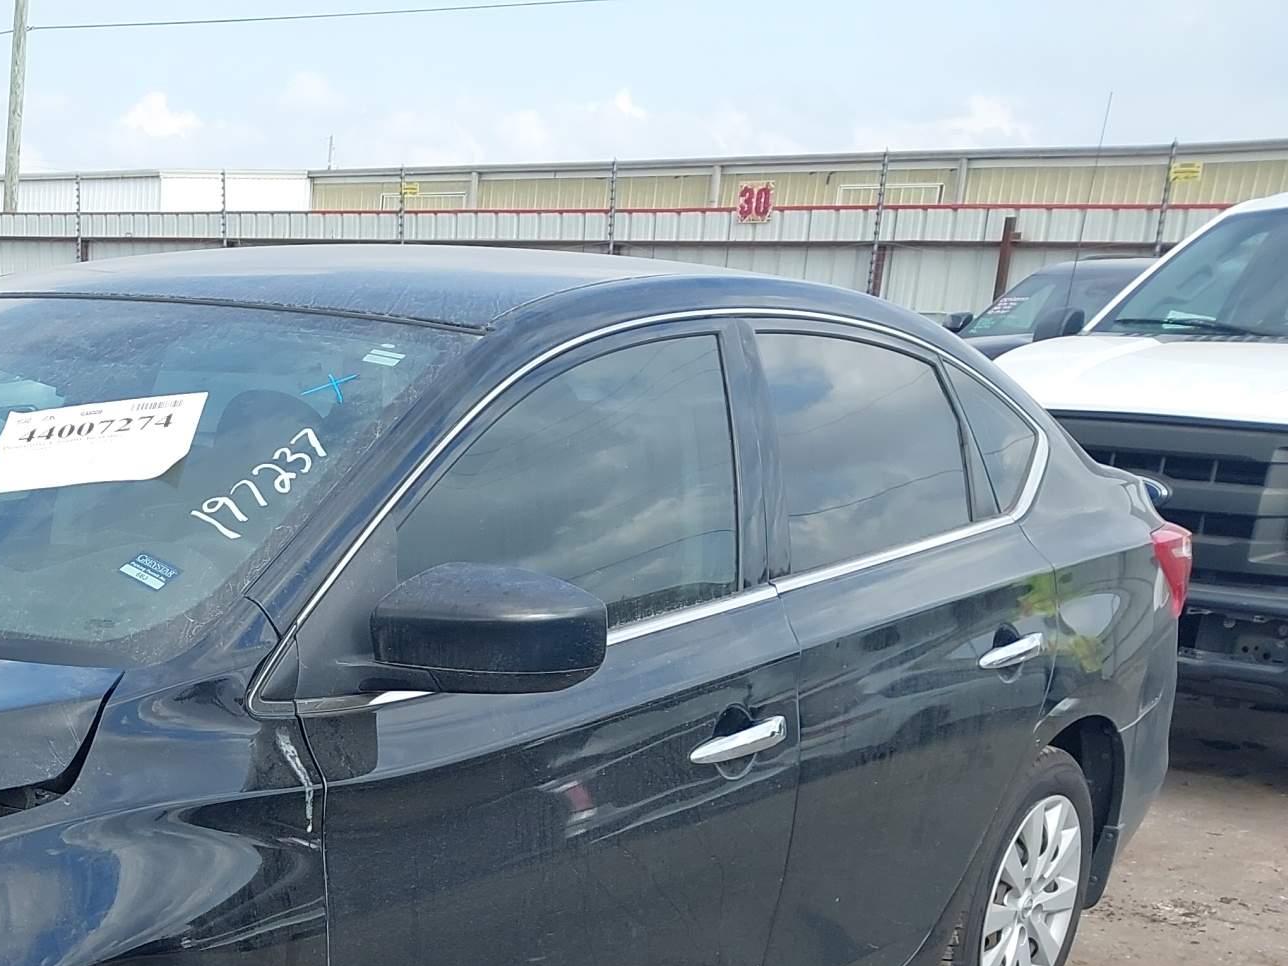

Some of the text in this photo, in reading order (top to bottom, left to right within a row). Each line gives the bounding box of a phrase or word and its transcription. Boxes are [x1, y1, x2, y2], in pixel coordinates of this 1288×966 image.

[739, 186, 772, 219] 30
[18, 413, 174, 442] 44007274
[190, 427, 328, 539] 197237
